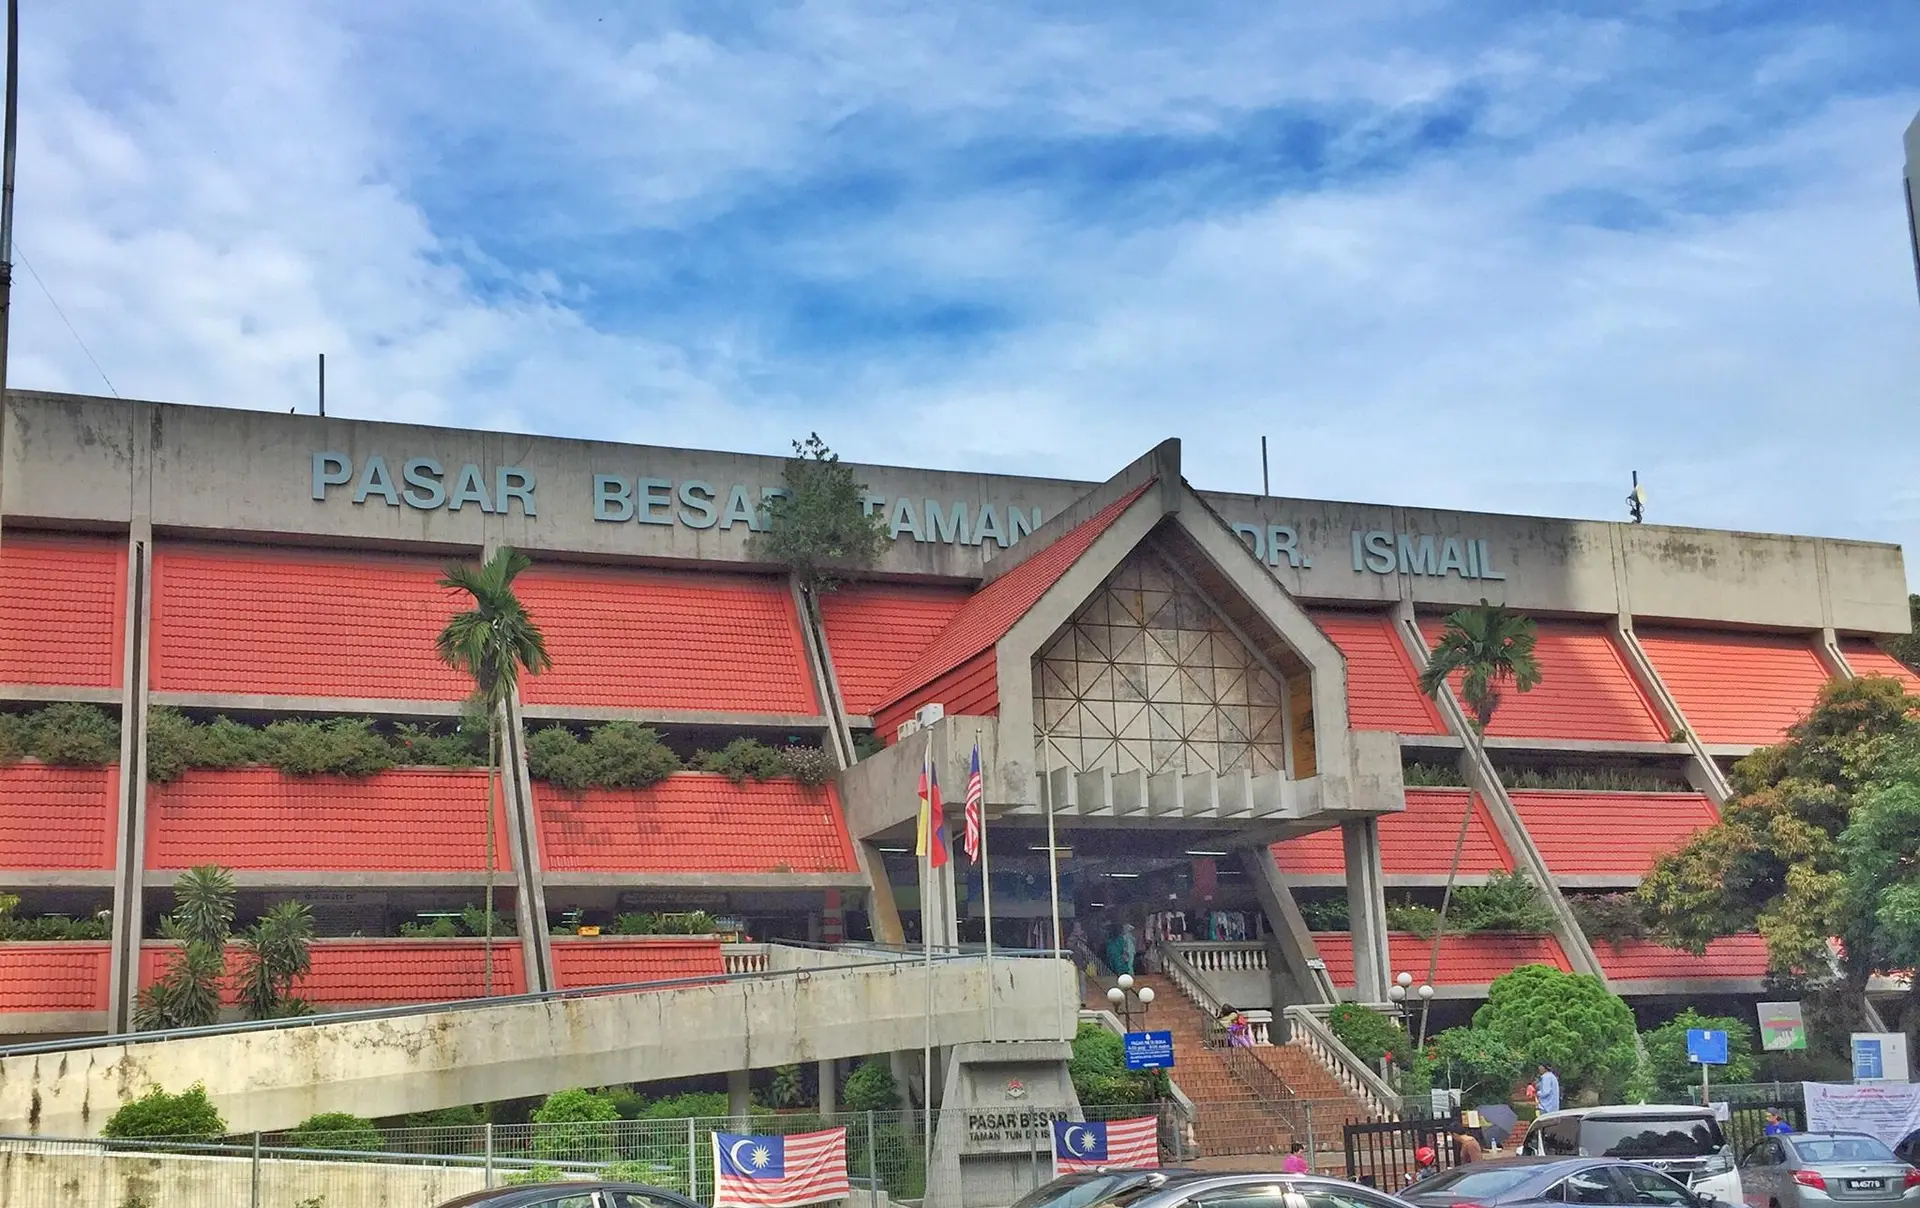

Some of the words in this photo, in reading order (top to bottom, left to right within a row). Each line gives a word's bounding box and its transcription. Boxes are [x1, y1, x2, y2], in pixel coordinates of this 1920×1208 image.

[312, 452, 537, 517] PASAR
[857, 495, 1042, 549] TAMAN
[1231, 522, 1312, 569] DR.
[1351, 530, 1506, 580] ISMAIL
[969, 1113, 1017, 1129] PASAR
[969, 1131, 1000, 1141] TAMAN
